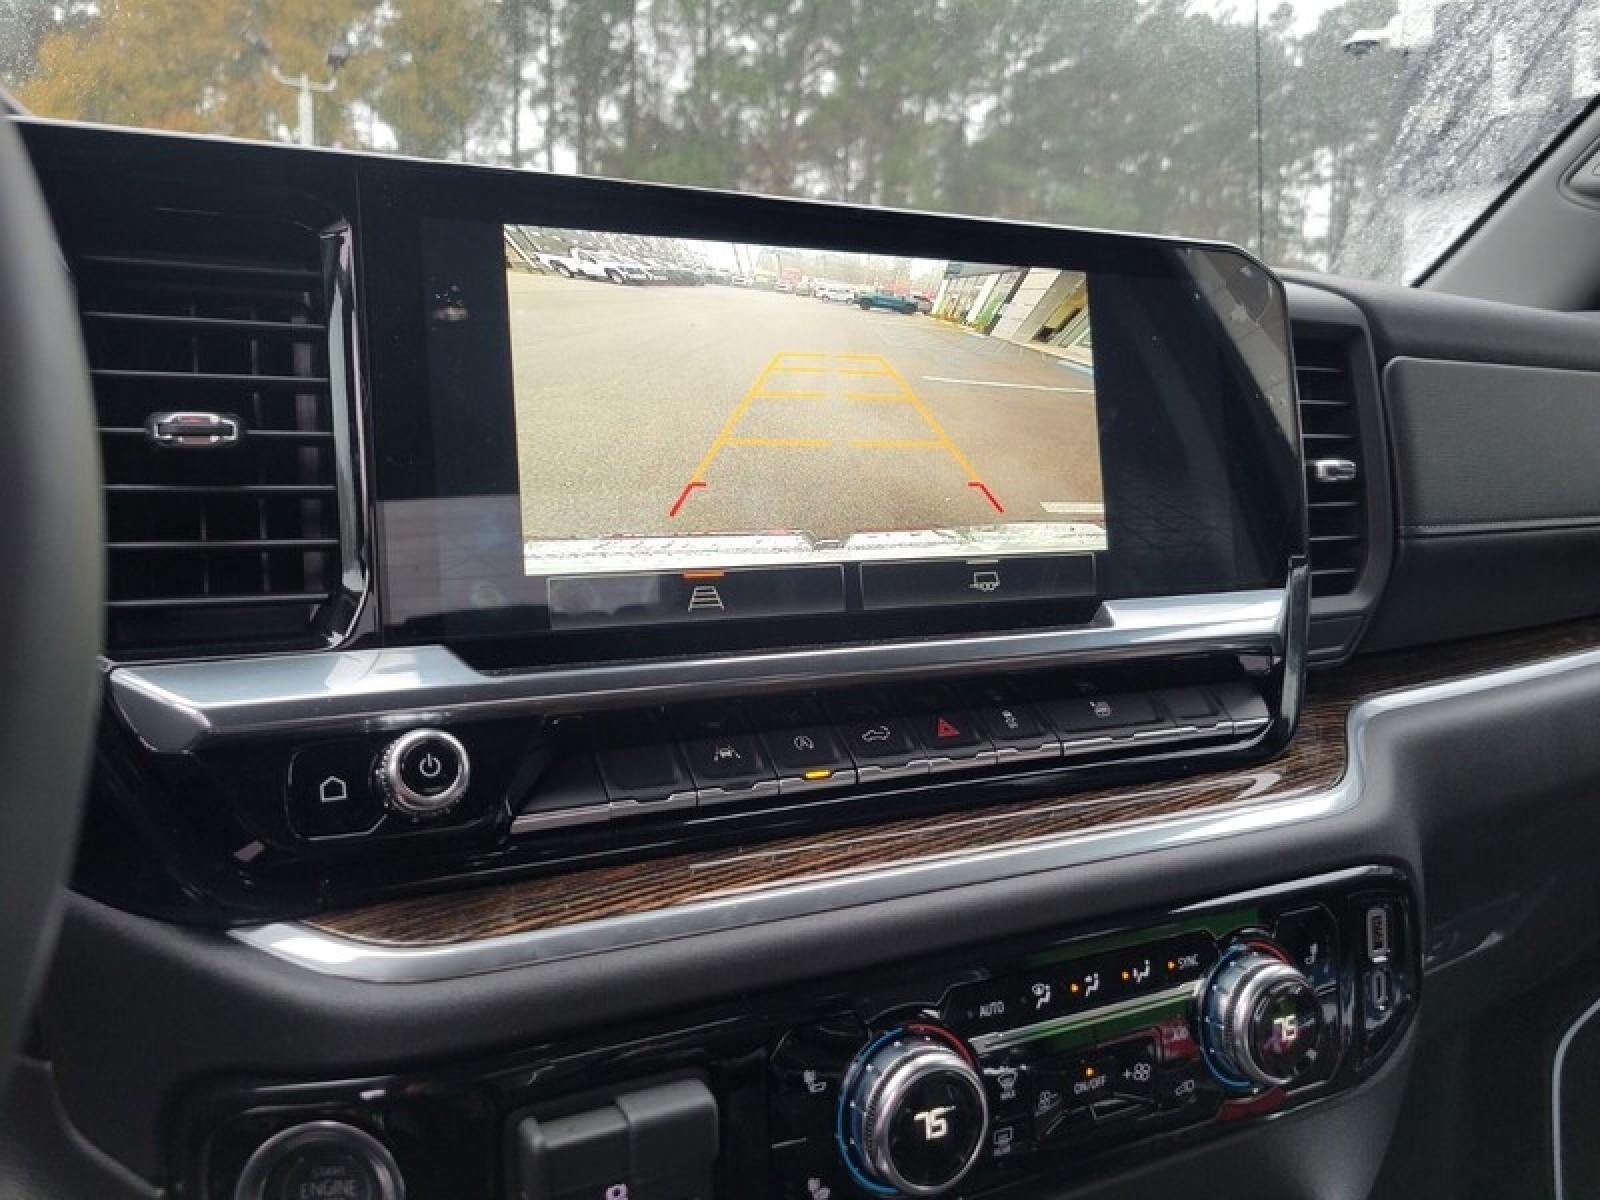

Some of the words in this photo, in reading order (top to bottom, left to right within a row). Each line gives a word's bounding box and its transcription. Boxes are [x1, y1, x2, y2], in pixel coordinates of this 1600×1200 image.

[980, 1000, 1005, 1017] AUTO
[1273, 1013, 1297, 1041] 75
[914, 1107, 953, 1142] 75
[299, 1178, 357, 1197] ENGINE
